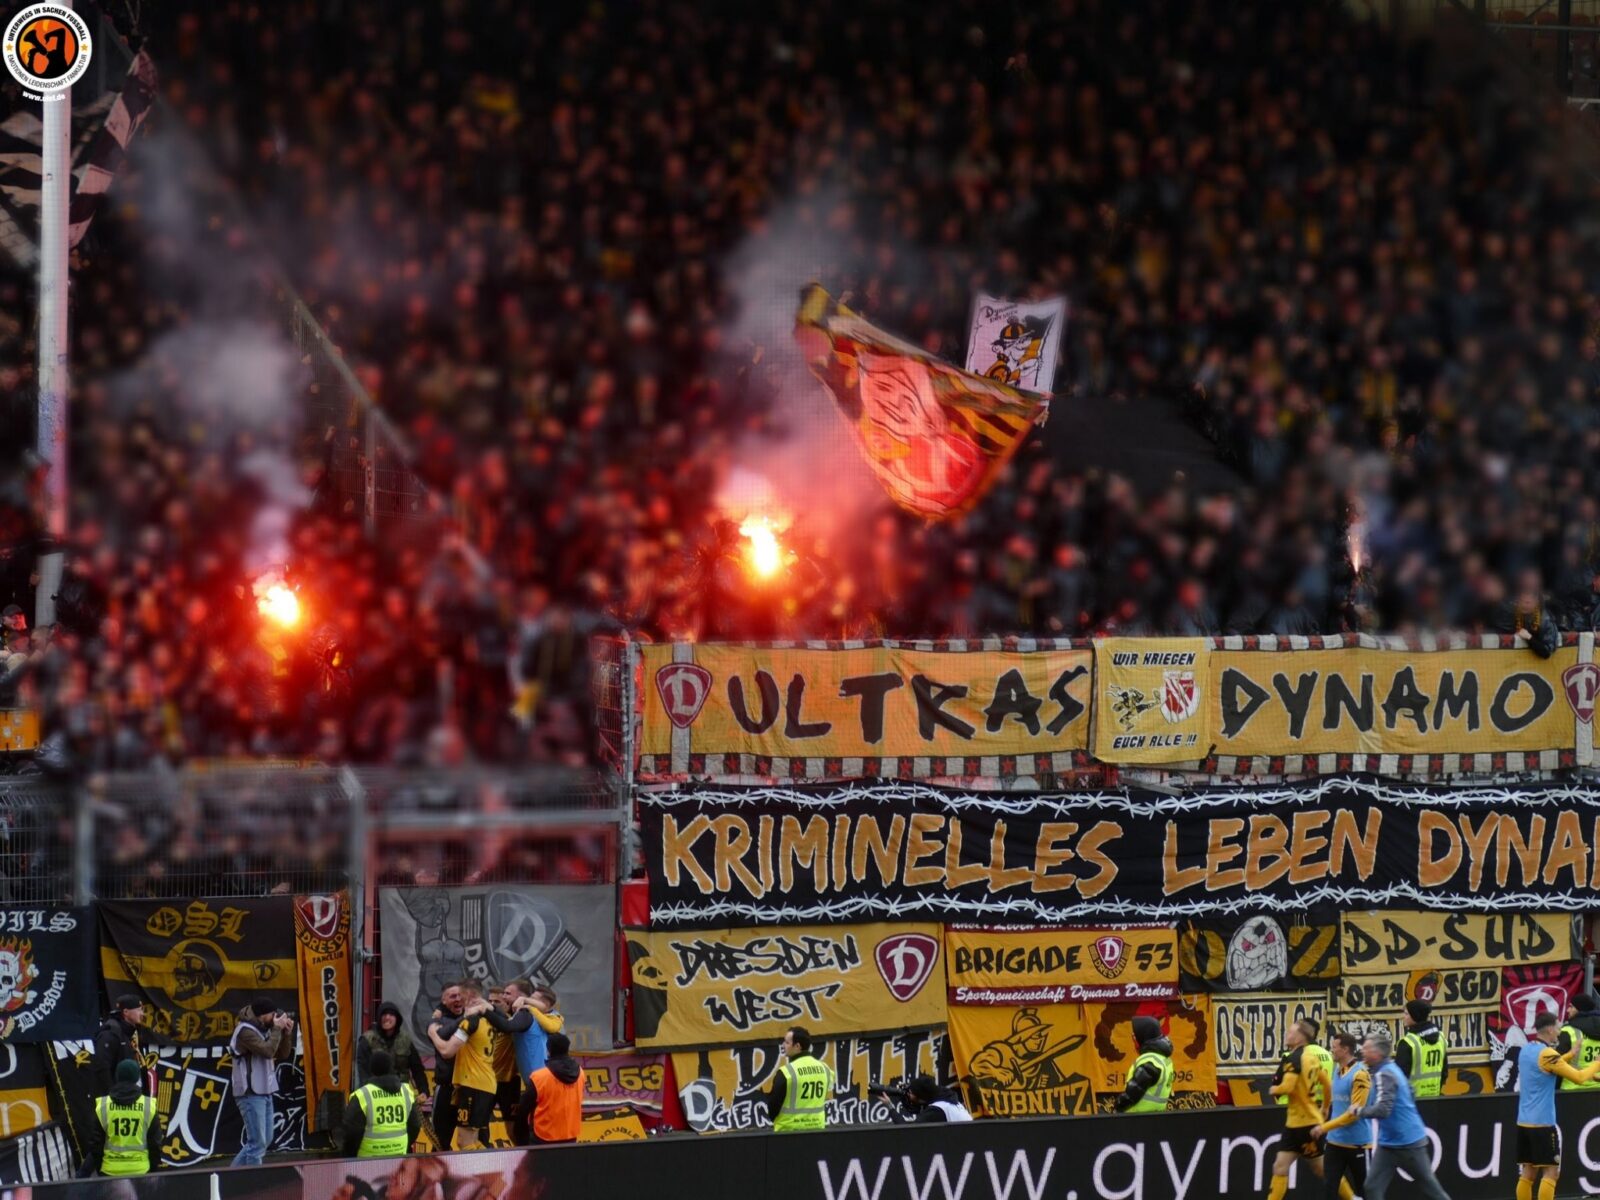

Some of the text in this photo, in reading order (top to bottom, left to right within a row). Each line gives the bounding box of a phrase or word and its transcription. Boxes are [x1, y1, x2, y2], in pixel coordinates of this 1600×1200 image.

[1112, 653, 1196, 665] WIR KRIEGEN
[726, 665, 1089, 745] ULTRAS
[1219, 664, 1555, 741] DYNAMO
[1112, 735, 1146, 749] EUCH
[1149, 734, 1183, 747] ALLE
[661, 806, 1600, 901] KRIMINELLES LEBEN DYNA
[670, 933, 861, 988] DRESDEN
[955, 942, 1173, 974] BRIGADE 53
[14, 970, 68, 1033] Dresden
[955, 982, 1174, 1002] Sportgemeinschaft Dynamo Dresden
[1443, 970, 1500, 1002] SGD
[703, 981, 843, 1031] WEST
[322, 966, 341, 1087] PROHLIS
[618, 1064, 664, 1092] 53
[798, 1066, 825, 1076] ORDNER
[801, 1081, 824, 1099] 276
[960, 1079, 1092, 1119] LEUBNITZ
[112, 1117, 140, 1136] 137
[376, 1104, 404, 1124] 339
[457, 1108, 468, 1122] 30
